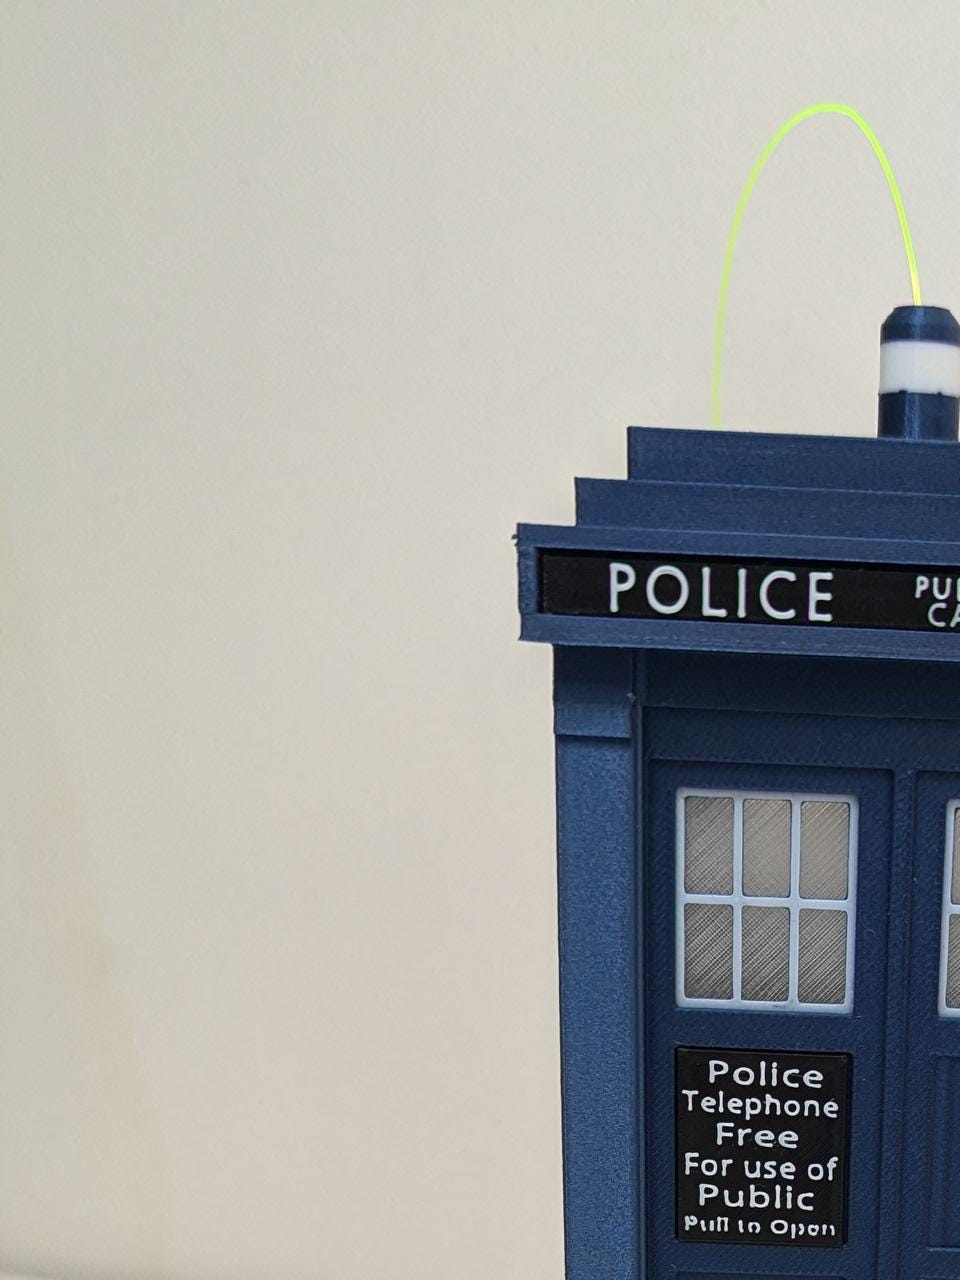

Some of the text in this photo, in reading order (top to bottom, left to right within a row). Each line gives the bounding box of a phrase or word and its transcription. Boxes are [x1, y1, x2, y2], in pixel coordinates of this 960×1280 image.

[609, 562, 834, 622] POLICE
[708, 1059, 824, 1089] Police
[681, 1089, 839, 1121] Telephone
[716, 1122, 799, 1149] Free
[684, 1151, 839, 1181] For use of
[698, 1183, 815, 1211] Public
